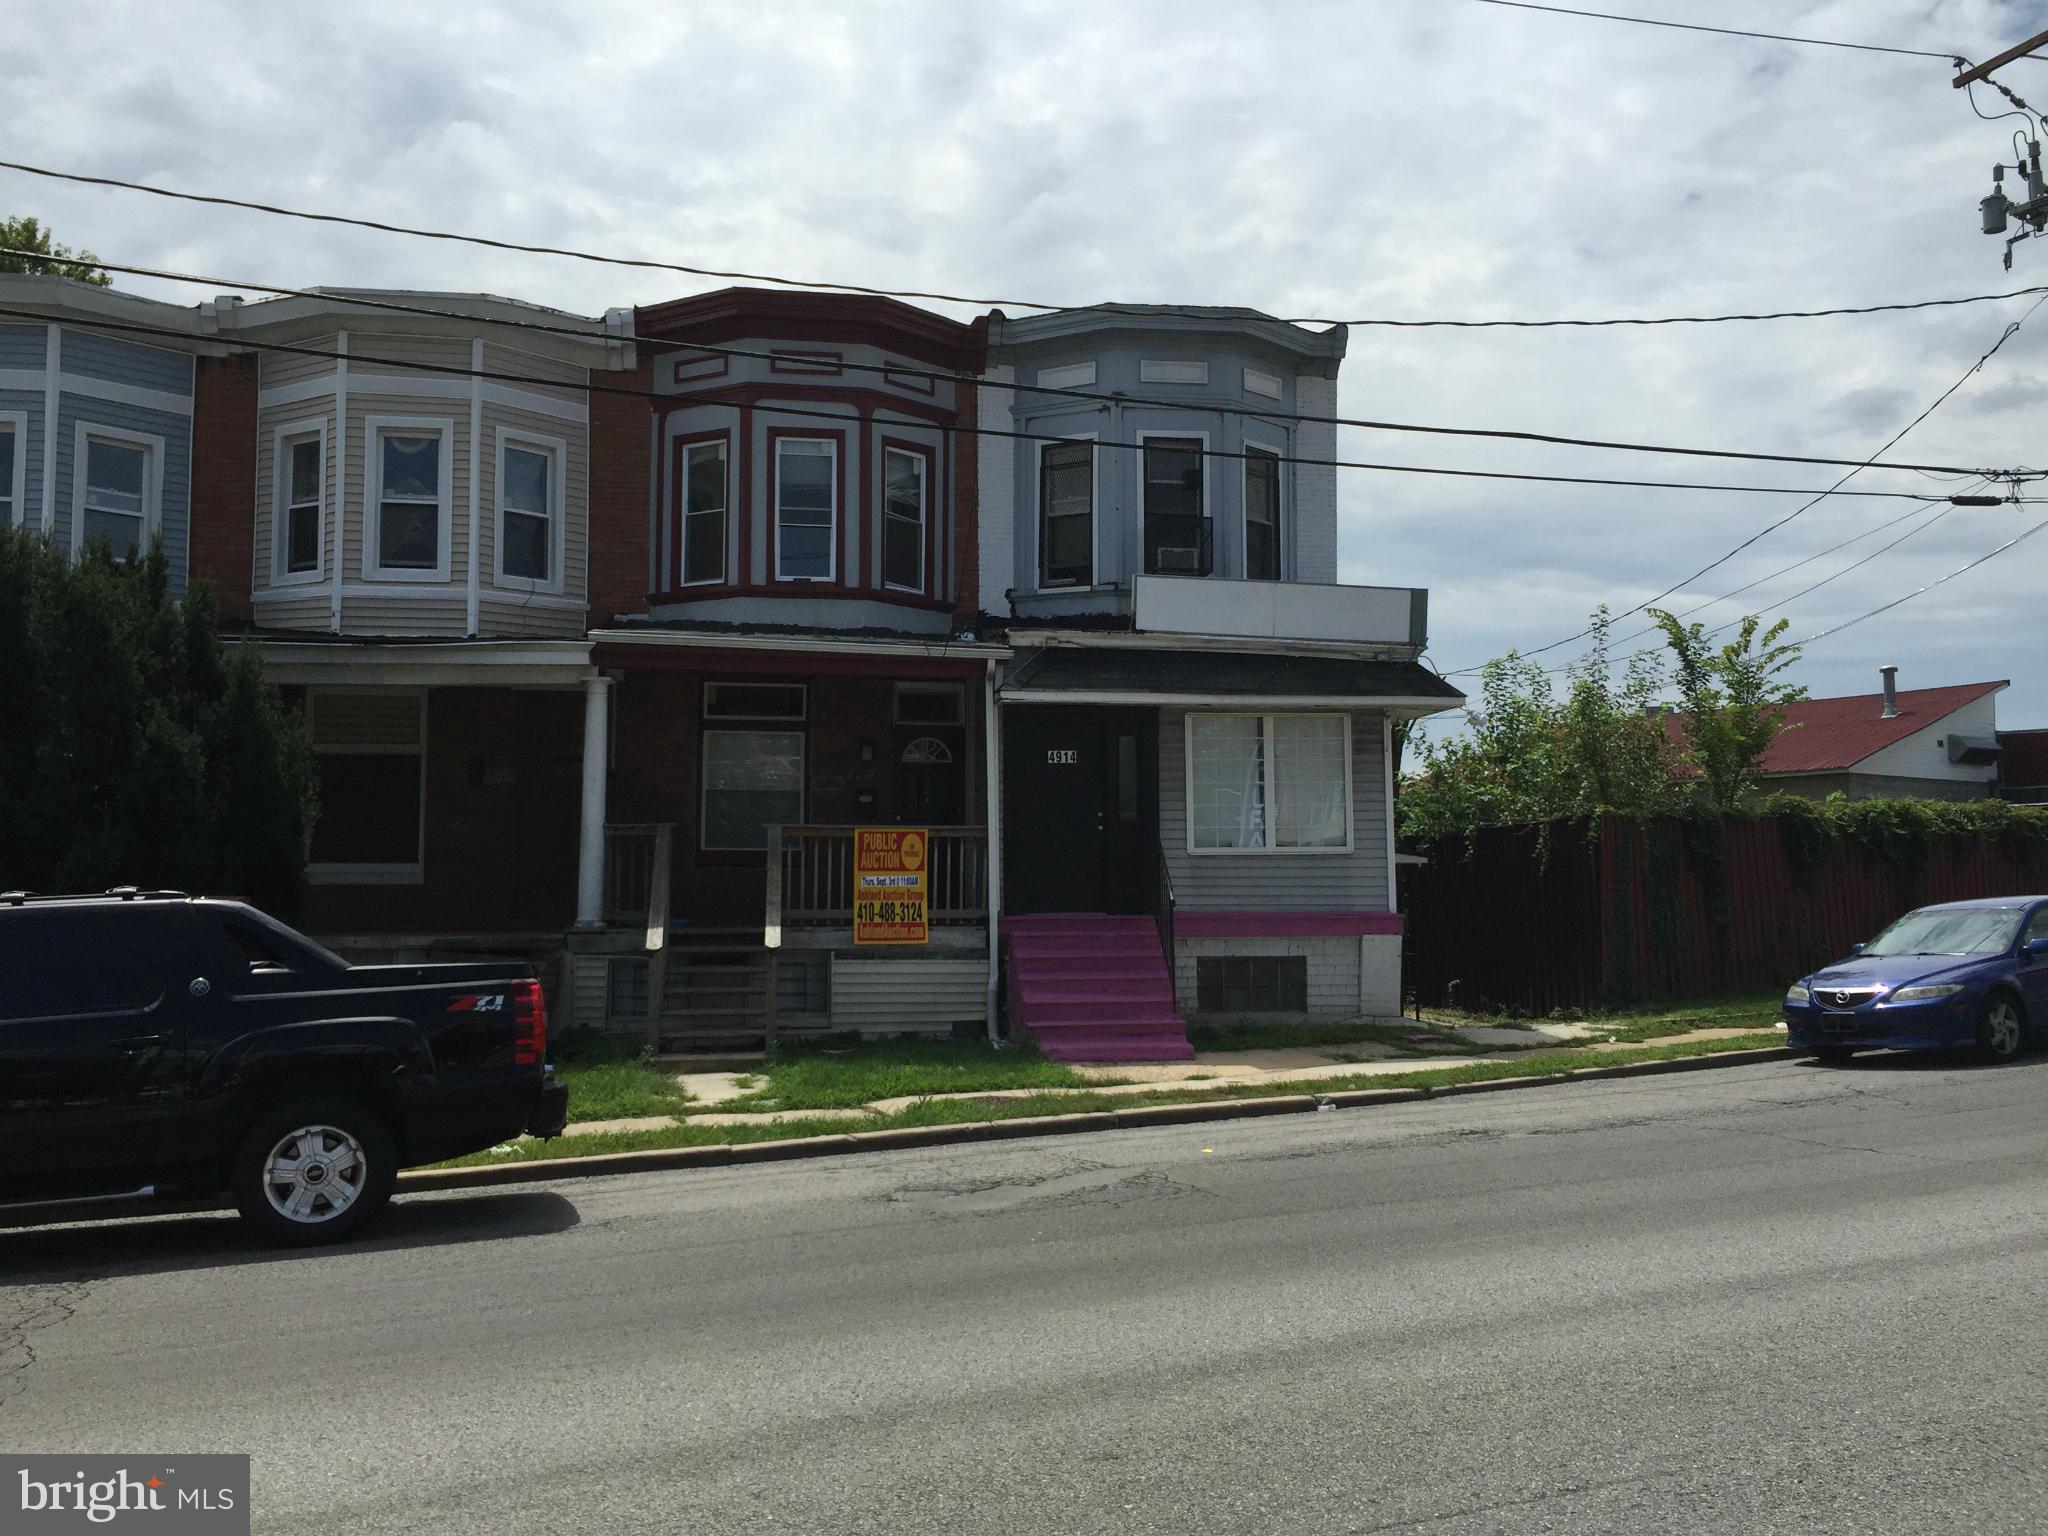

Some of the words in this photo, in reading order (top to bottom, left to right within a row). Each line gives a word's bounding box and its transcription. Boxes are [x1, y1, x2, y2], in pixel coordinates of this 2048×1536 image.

[1049, 751, 1077, 763] 4914
[863, 833, 897, 850] PUBLIC
[861, 851, 900, 869] AUCTION
[858, 902, 922, 922] 410-488-3124
